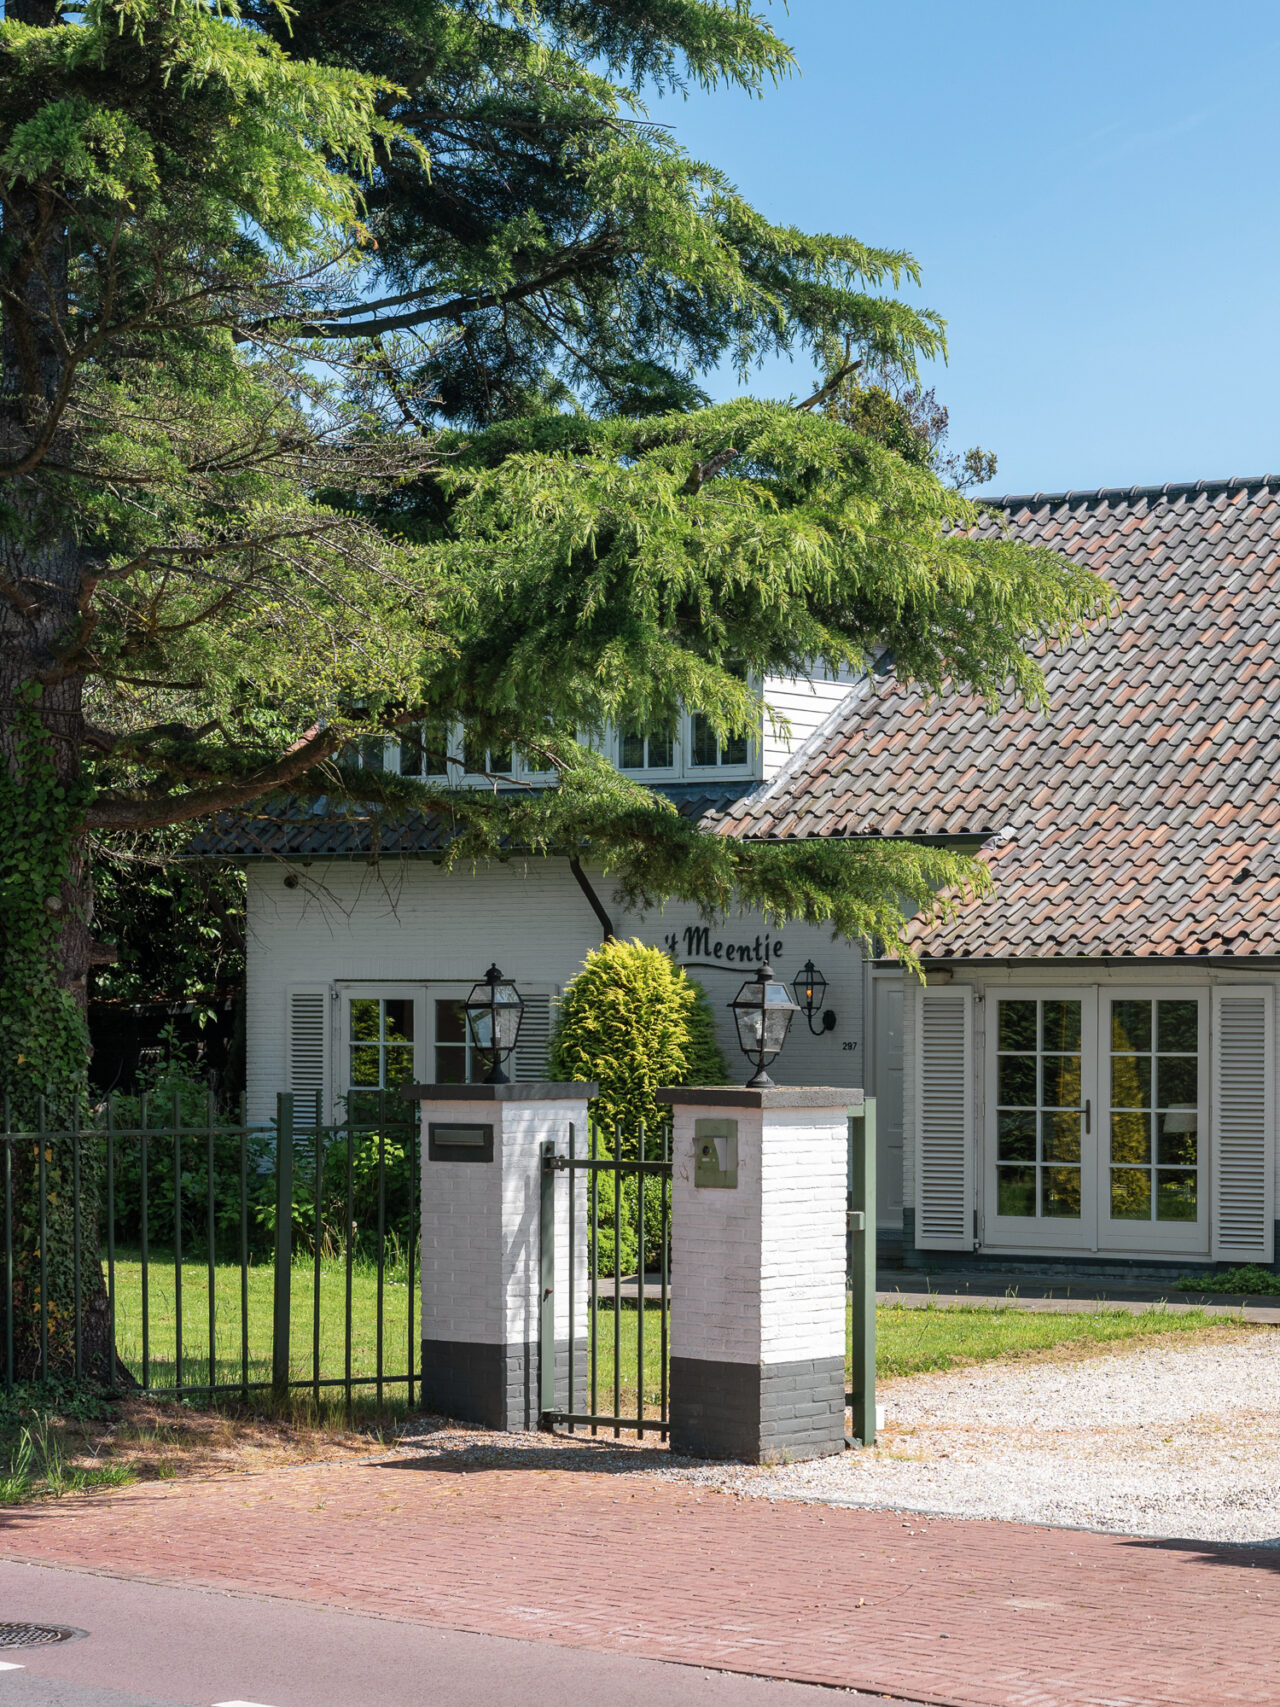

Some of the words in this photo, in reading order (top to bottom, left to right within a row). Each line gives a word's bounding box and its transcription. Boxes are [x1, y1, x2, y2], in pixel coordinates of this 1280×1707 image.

[664, 932, 679, 952] 't
[682, 926, 783, 966] Meentje
[842, 1041, 858, 1051] 297
